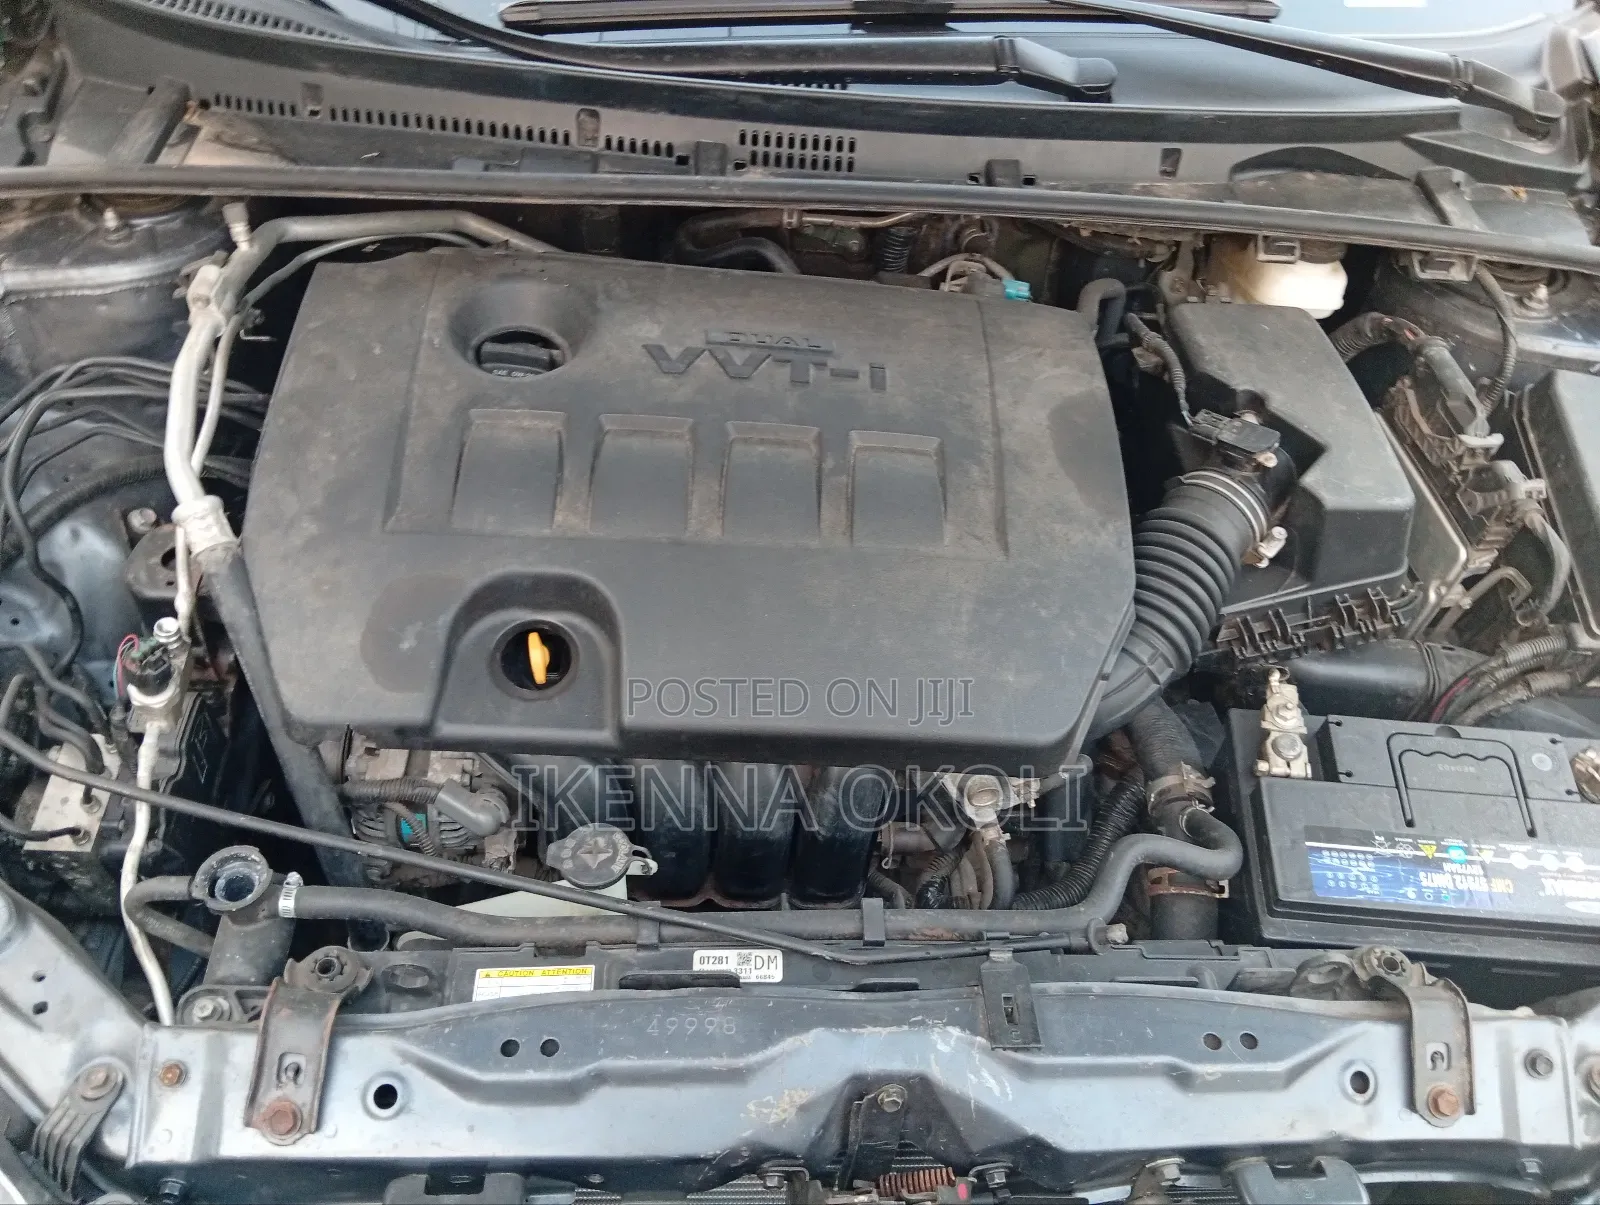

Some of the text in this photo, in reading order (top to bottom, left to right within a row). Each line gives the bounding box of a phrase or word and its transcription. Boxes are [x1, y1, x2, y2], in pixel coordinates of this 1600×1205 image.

[725, 331, 822, 349] DUAL
[754, 955, 778, 970] DM
[541, 968, 588, 976] ATTENTION
[646, 1016, 736, 1036] 49998
